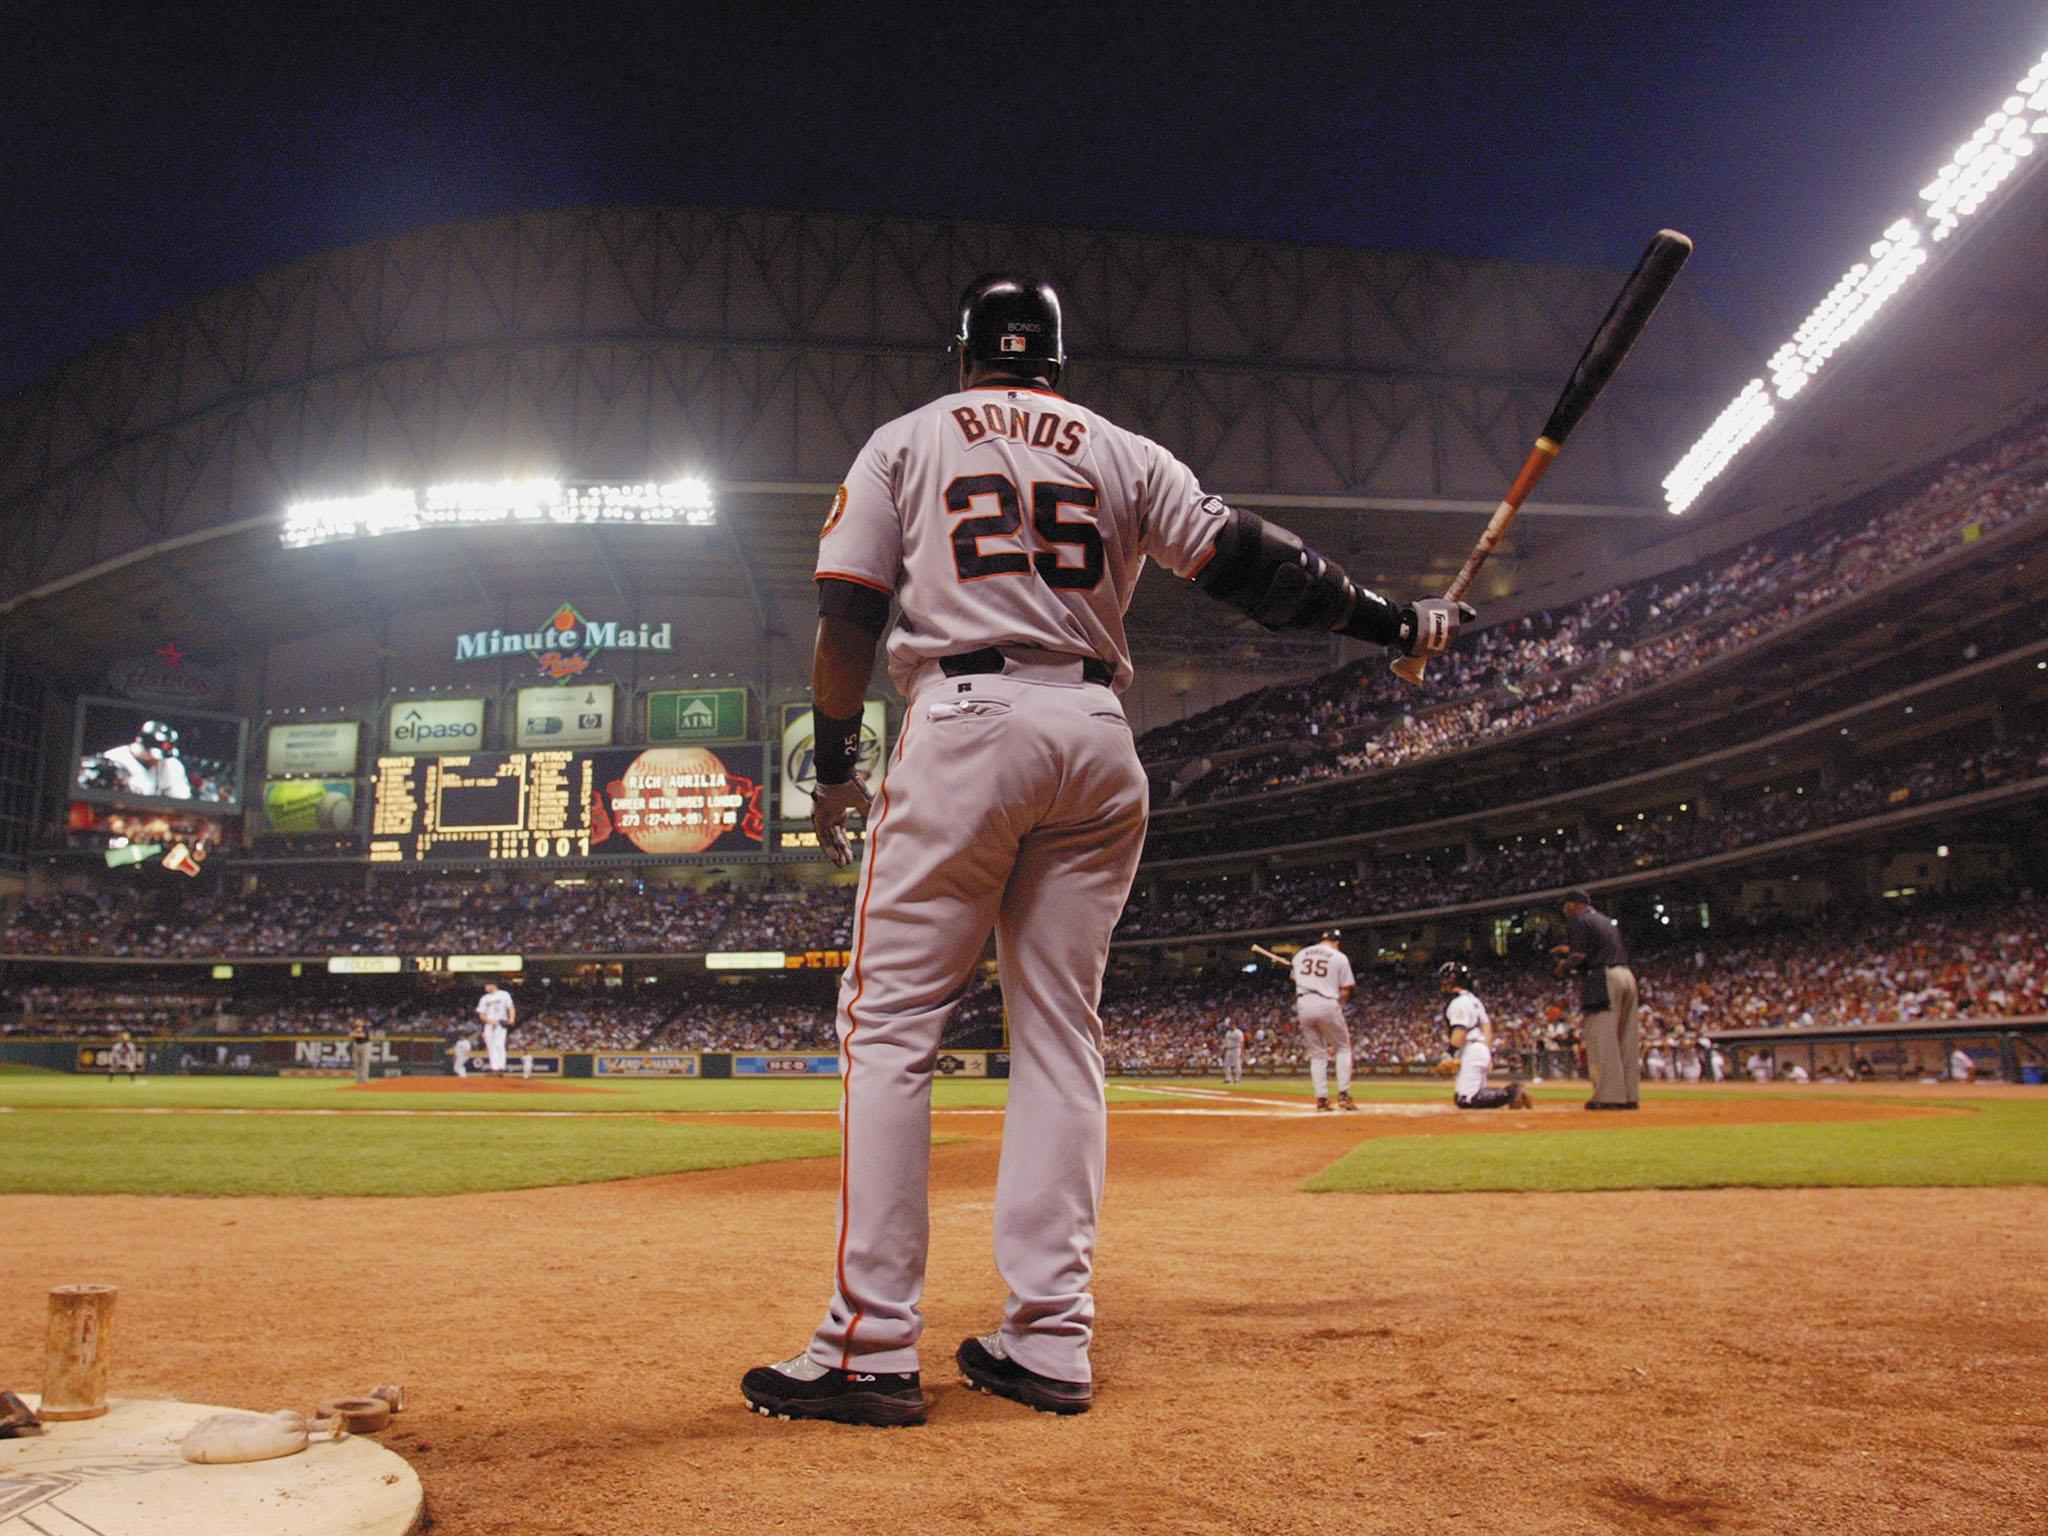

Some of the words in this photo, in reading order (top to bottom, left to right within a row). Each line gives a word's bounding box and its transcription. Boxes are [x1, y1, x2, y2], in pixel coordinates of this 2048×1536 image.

[1007, 322, 1041, 333] BONDS
[951, 404, 1087, 456] BONDS
[943, 473, 1105, 592] 25
[455, 627, 578, 661] Minute
[584, 621, 672, 650] Maid
[845, 733, 857, 756] 25
[629, 775, 662, 789] RICH
[668, 773, 727, 788] AURILIA
[535, 838, 549, 858] 0
[556, 837, 570, 857] 0
[577, 837, 590, 857] 1
[1300, 958, 1329, 978] 35
[295, 1041, 400, 1063] NEXEL
